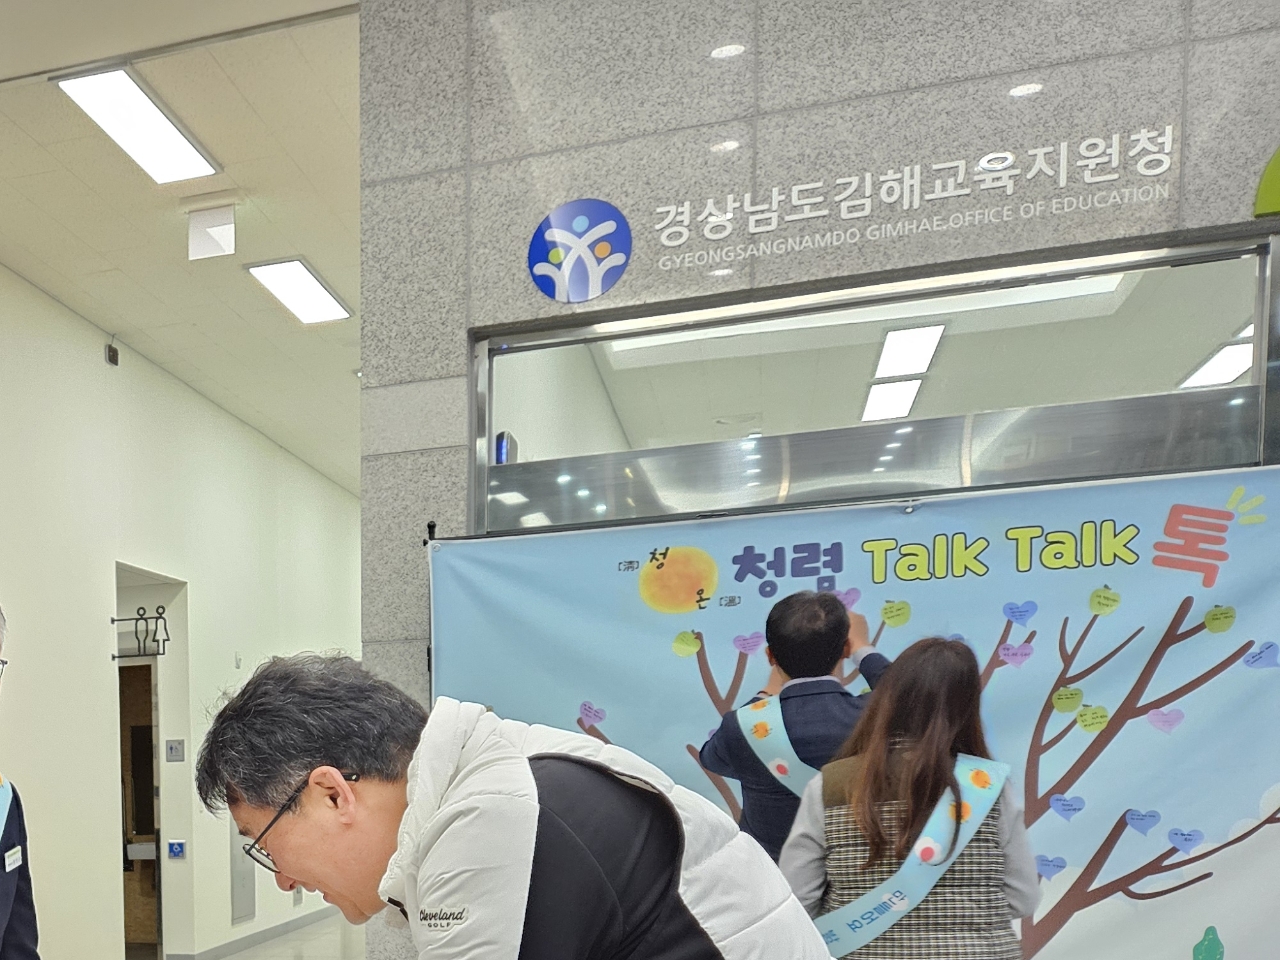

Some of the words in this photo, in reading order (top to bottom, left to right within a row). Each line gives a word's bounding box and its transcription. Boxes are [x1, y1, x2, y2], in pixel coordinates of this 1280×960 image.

[653, 125, 1175, 248] 경상남도김해교육지원청
[657, 228, 861, 271] GYEONGSANGNAMDO
[948, 202, 1015, 231] OFFICE
[1019, 199, 1045, 219] OF
[1048, 181, 1171, 214] EDUCATION
[731, 541, 844, 599] 청렴
[861, 531, 991, 585] Talk
[1005, 519, 1141, 573] Talk
[1151, 502, 1236, 590] 톡
